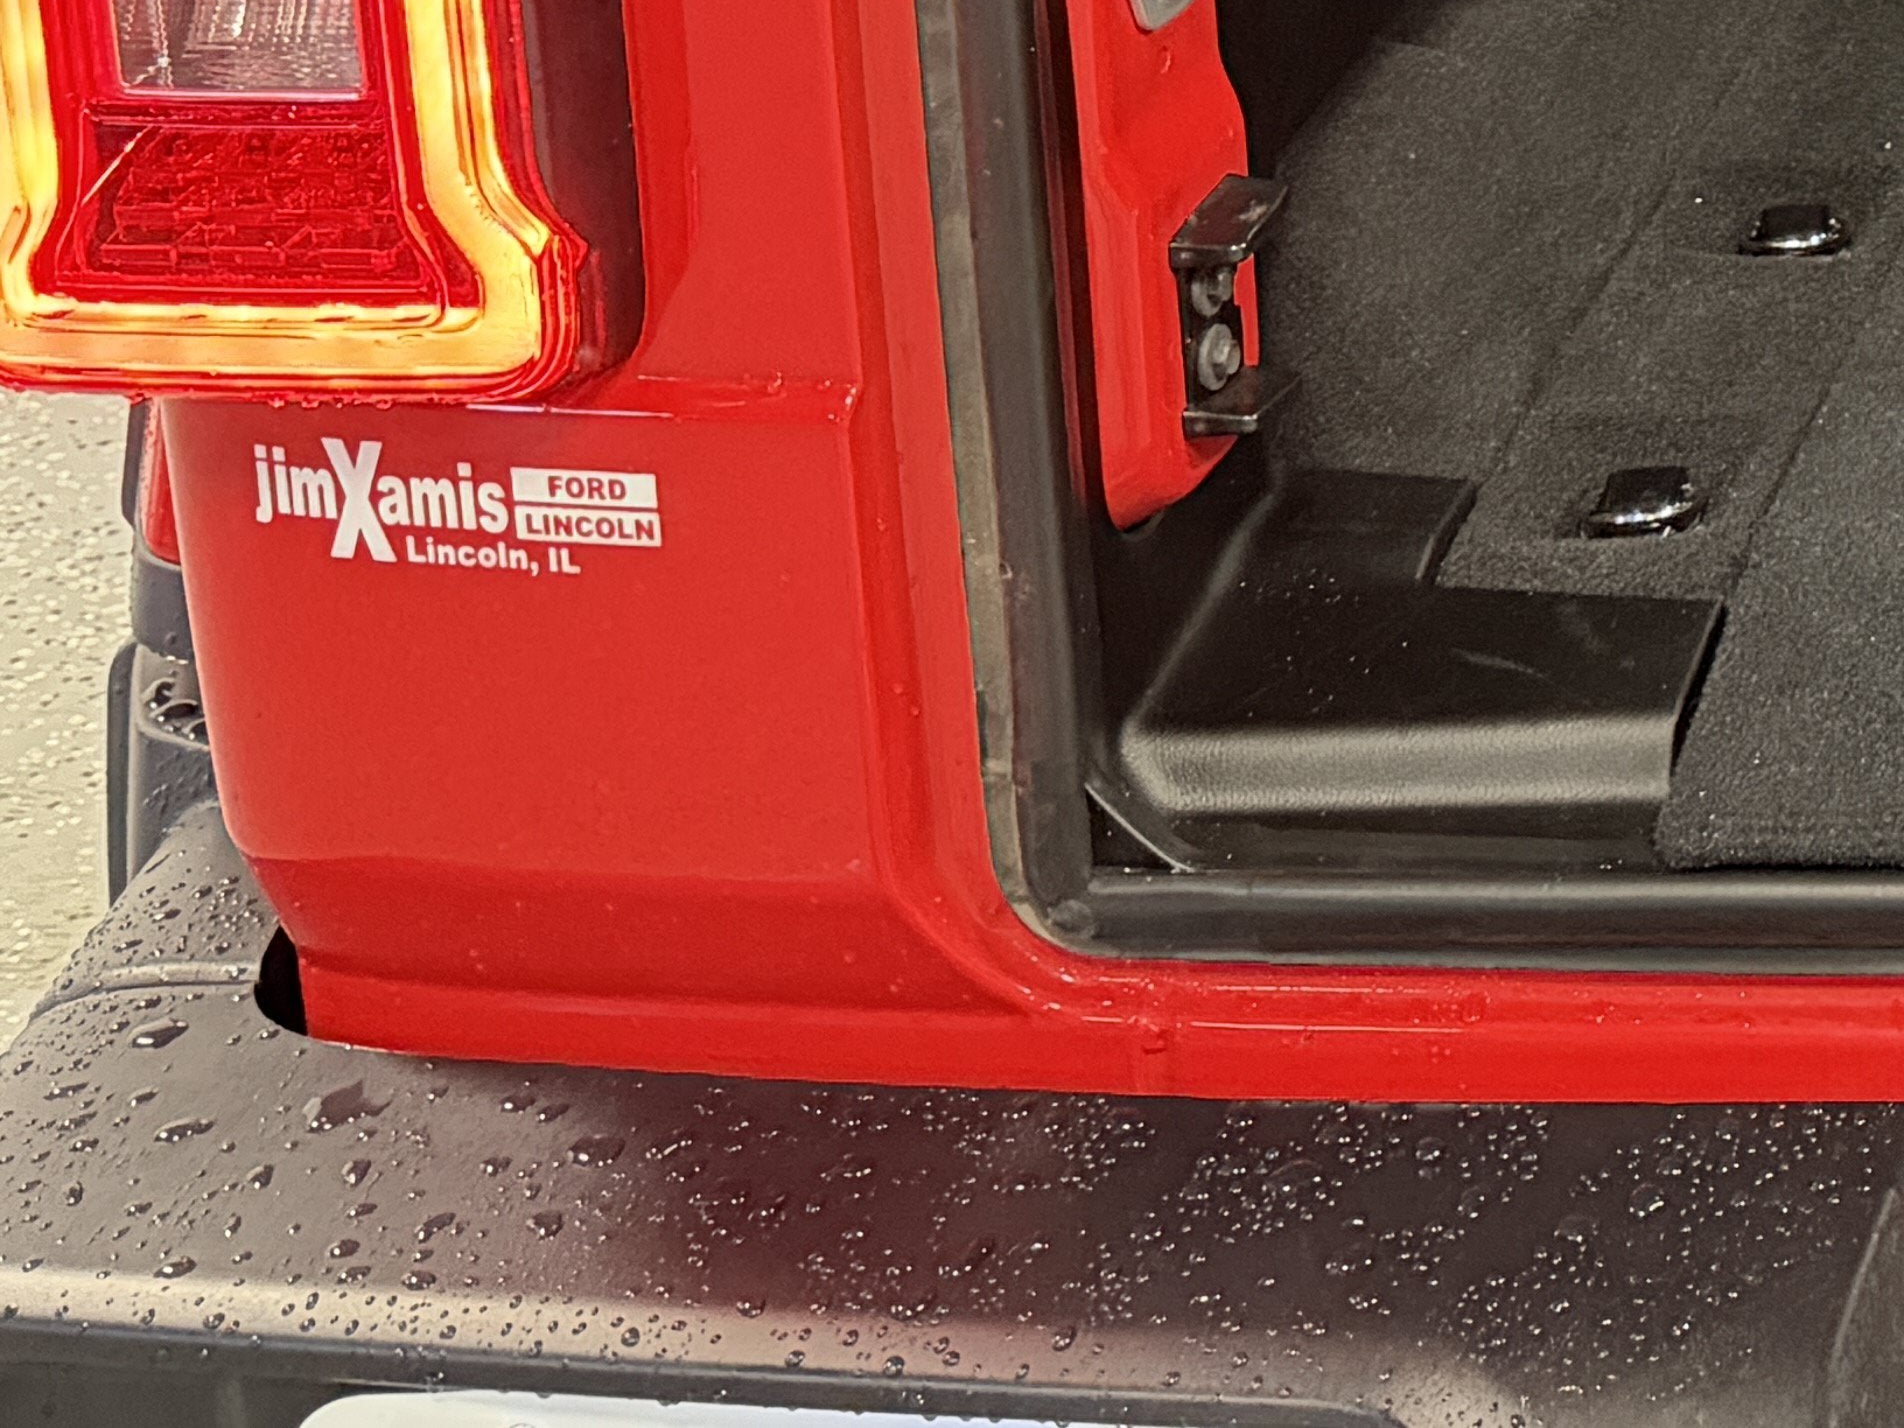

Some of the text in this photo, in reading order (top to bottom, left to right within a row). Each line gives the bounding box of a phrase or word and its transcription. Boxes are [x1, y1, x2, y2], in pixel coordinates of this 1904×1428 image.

[547, 475, 627, 501] FORD
[525, 513, 656, 541] LINCOLN
[405, 535, 582, 577] Lincoln, IL
